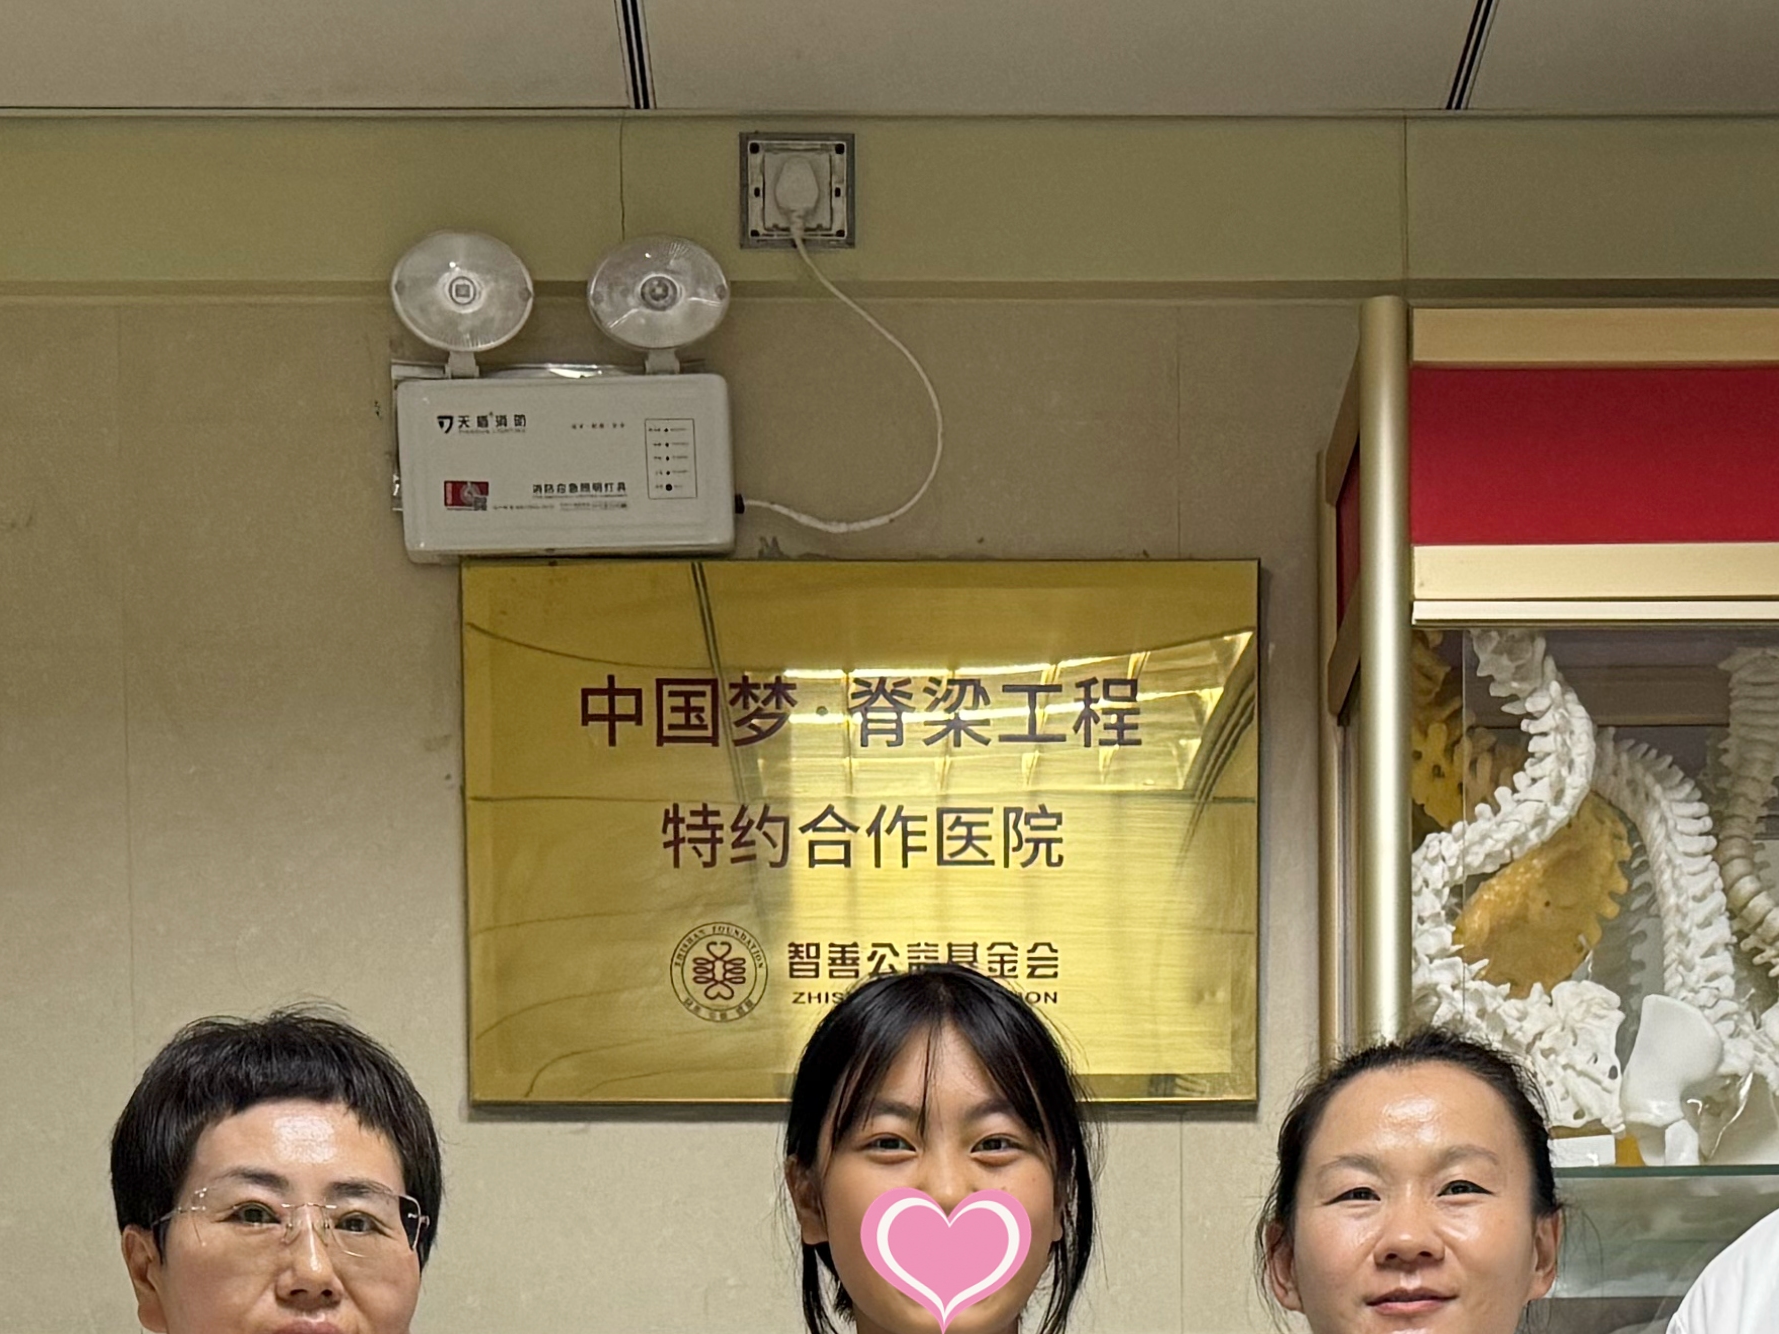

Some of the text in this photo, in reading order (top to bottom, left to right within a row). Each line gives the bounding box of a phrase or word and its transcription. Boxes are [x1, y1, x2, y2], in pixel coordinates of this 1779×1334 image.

[580, 674, 1143, 749] 中国梦·脊梁工程
[660, 802, 1065, 870] 特约合作医院
[791, 991, 844, 1005] ZHIS
